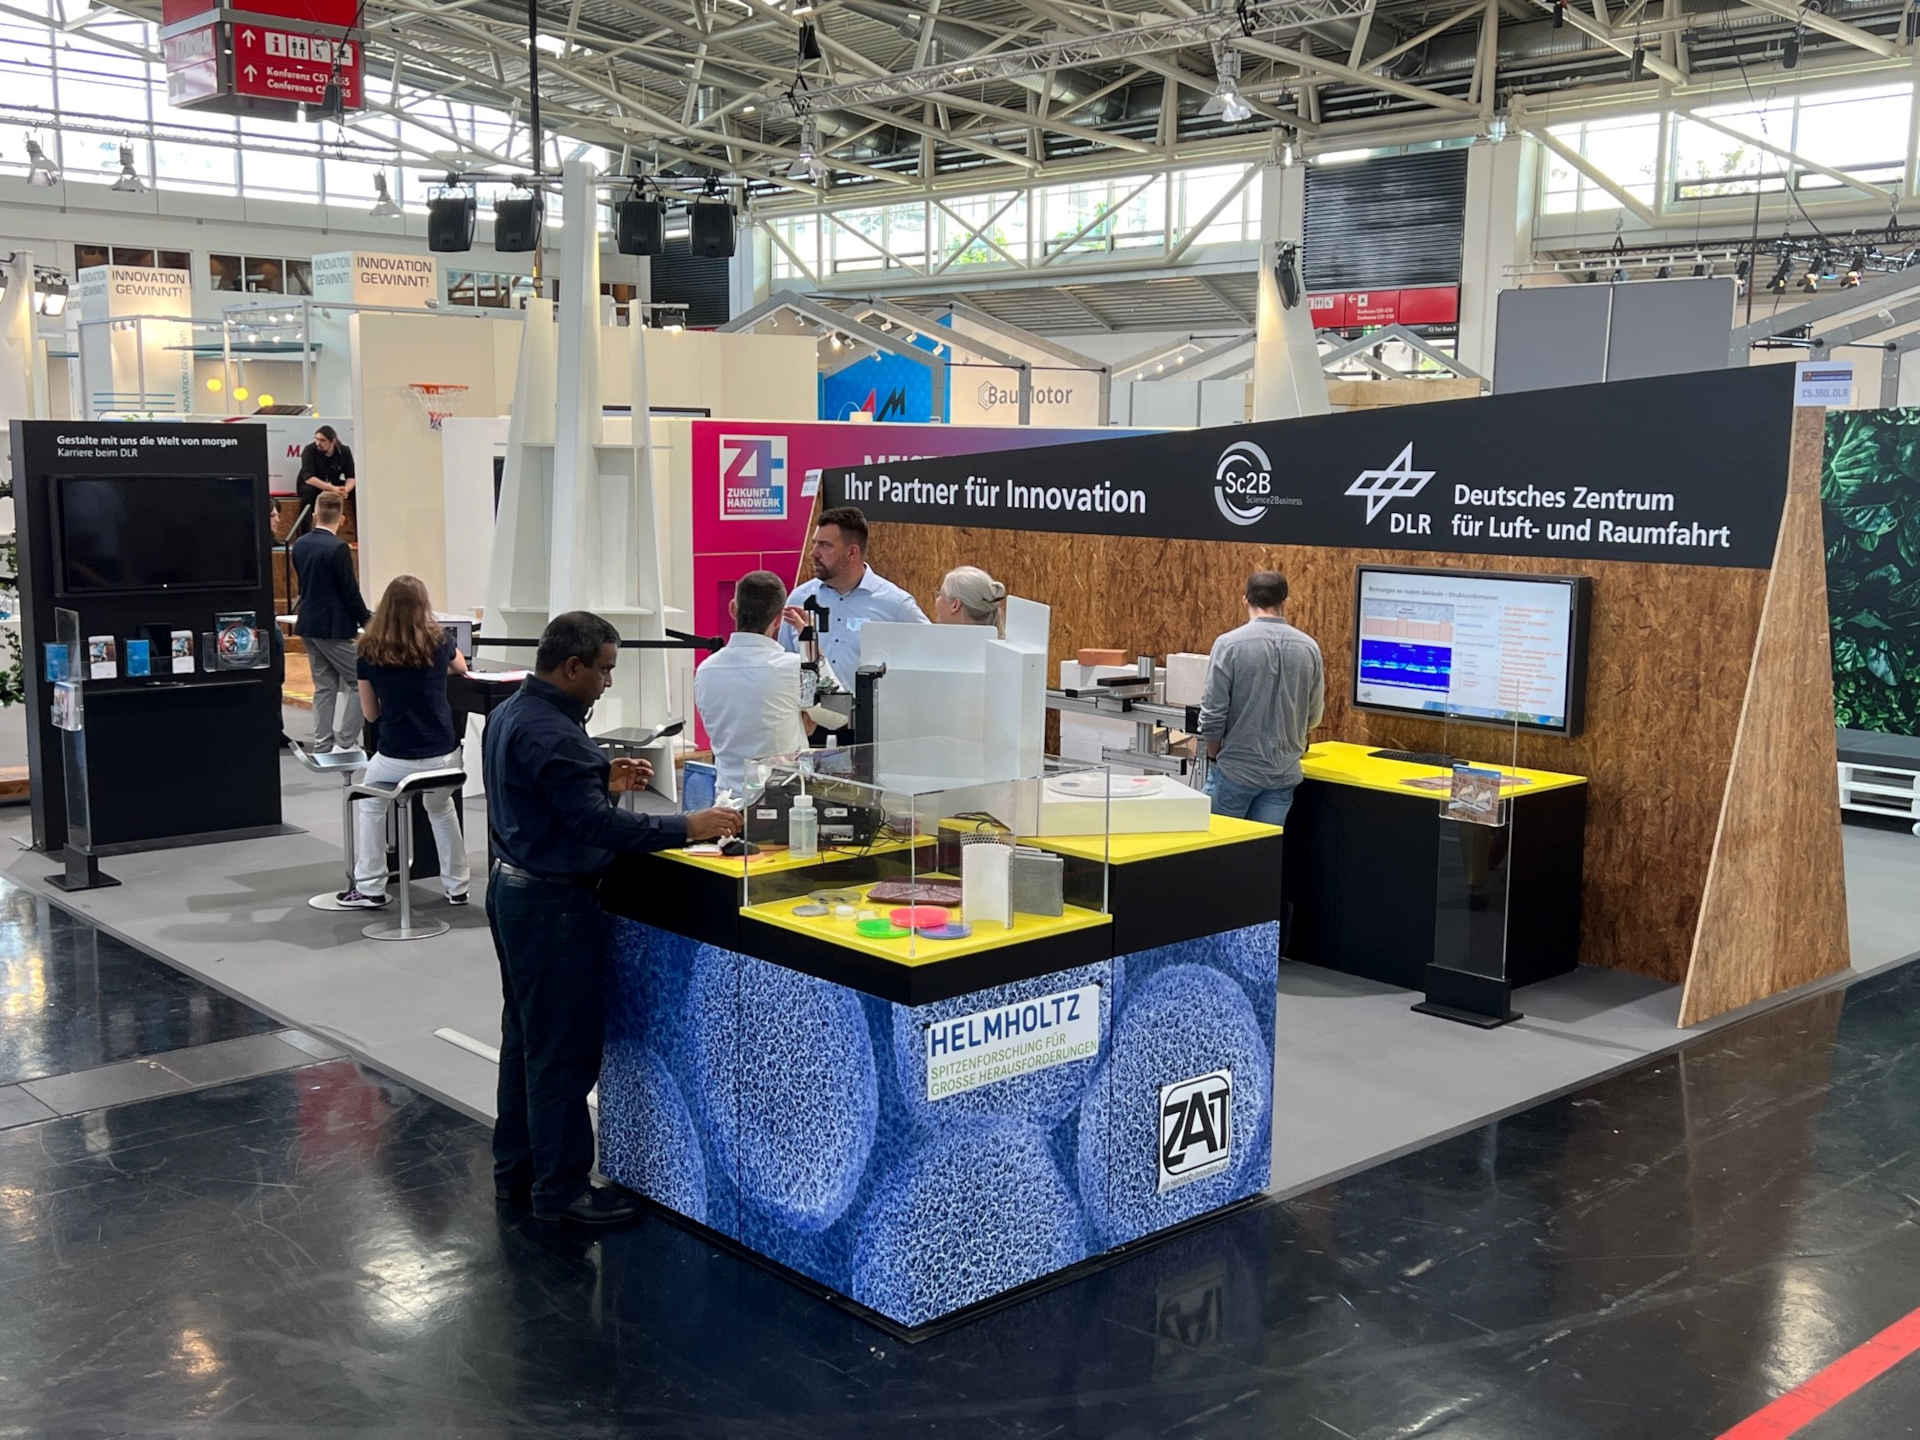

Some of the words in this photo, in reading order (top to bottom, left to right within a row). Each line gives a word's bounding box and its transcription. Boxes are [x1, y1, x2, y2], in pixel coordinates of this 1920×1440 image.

[267, 78, 313, 94] Conference
[357, 256, 432, 272] INNOVATION
[111, 270, 185, 285] INNOVATION
[361, 272, 430, 288] GEWINNT!
[115, 284, 183, 297] GEWINNT!
[988, 385, 1072, 405] Bauotor
[57, 435, 99, 446] Gestalte
[101, 436, 118, 446] mit
[120, 437, 138, 446] uns
[139, 435, 155, 446] die
[157, 436, 180, 446] Welt
[181, 438, 200, 446] von
[202, 438, 238, 448] morgen
[57, 448, 93, 458] Karriere
[95, 448, 118, 458] beim
[120, 448, 138, 458] DLR
[1225, 471, 1271, 494] Sc2B
[727, 488, 770, 497] ZUKUNFT
[845, 473, 872, 500] Ihr
[878, 475, 959, 504] Partner
[965, 476, 1000, 507] für
[1007, 480, 1146, 513] Innovation
[1454, 484, 1566, 508] Deutsches
[1572, 486, 1674, 511] Zentrum
[727, 498, 780, 508] HANDWERK
[1390, 512, 1432, 535] DLR
[1451, 514, 1483, 537] für
[1488, 516, 1540, 540] Luft-
[1546, 519, 1591, 541] und
[1598, 520, 1730, 547] Raumfahrt
[931, 993, 1080, 1057] HELMHOLTZ
[931, 1039, 1043, 1080] SPITZENFORSCHUNG
[1045, 1032, 1067, 1050] FÜR
[931, 1076, 980, 1096] GROSSE
[979, 1039, 1098, 1082] HERAUSFORDERUNGEN
